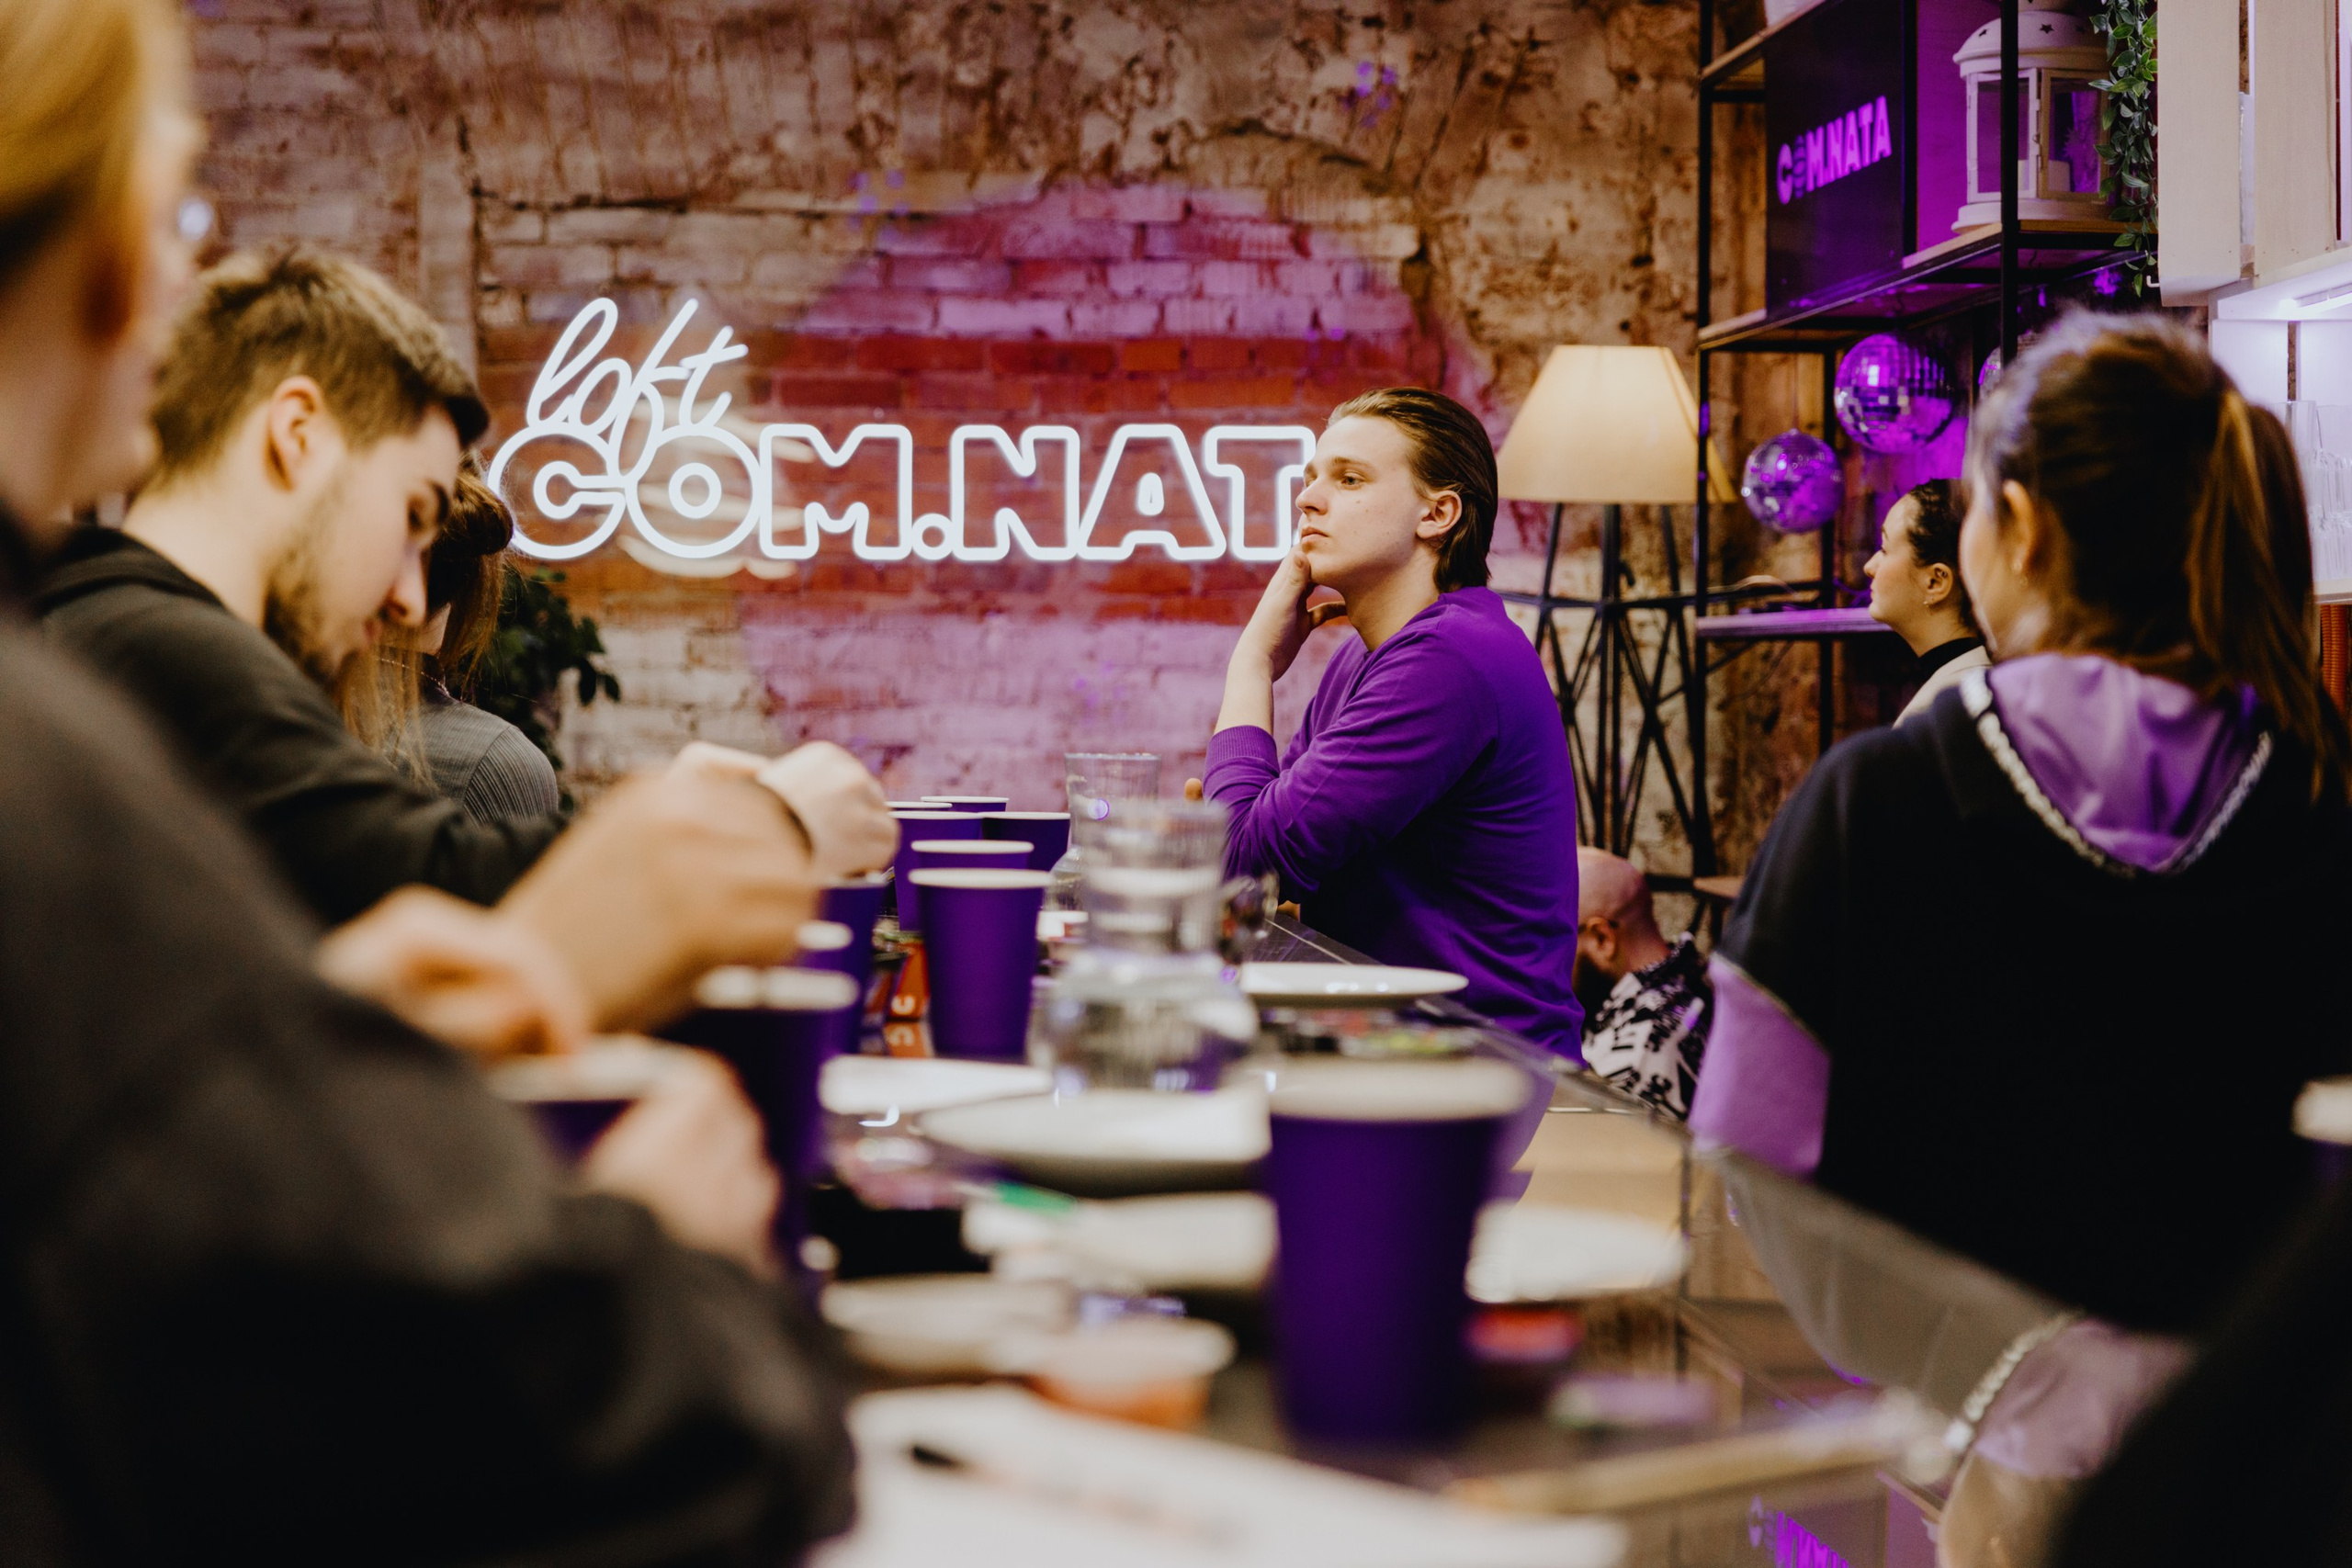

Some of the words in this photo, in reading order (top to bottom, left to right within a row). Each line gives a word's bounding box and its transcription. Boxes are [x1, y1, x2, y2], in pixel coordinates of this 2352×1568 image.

[1777, 95, 1893, 205] COM.NATA
[526, 297, 748, 479] loft
[487, 423, 1317, 561] COM.NAT
